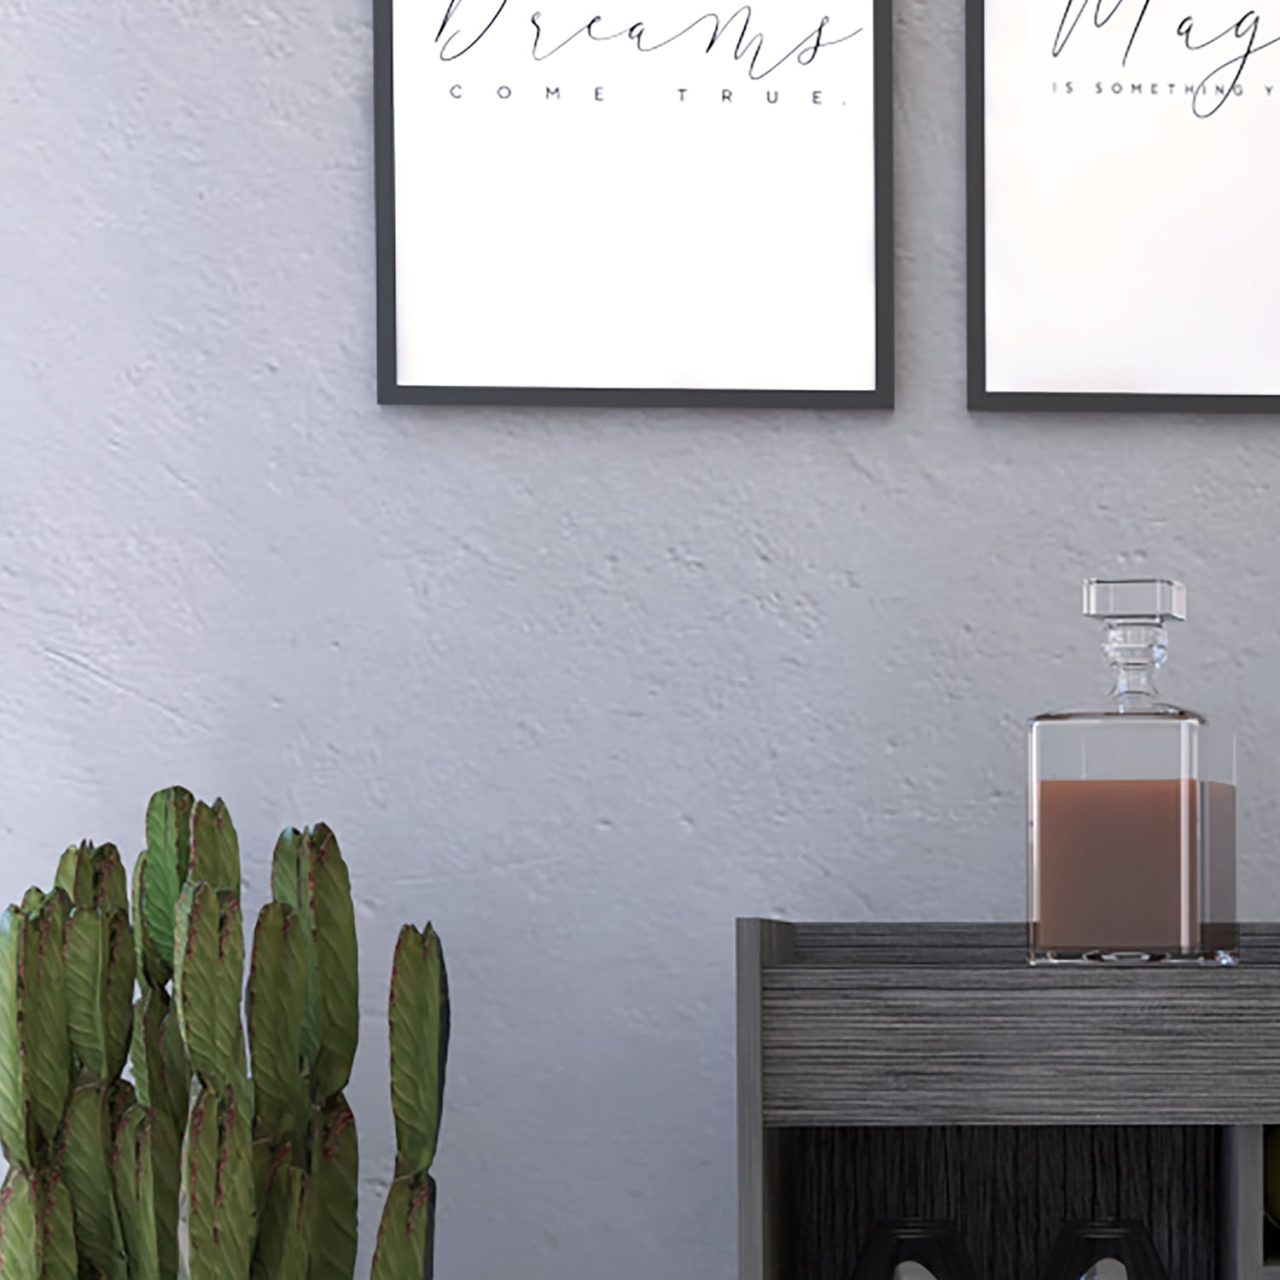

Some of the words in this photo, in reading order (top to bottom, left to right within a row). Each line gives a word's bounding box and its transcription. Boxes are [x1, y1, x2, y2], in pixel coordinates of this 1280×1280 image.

[448, 83, 605, 102] COME
[1051, 80, 1075, 95] IS
[1094, 81, 1244, 97] SOMETHING
